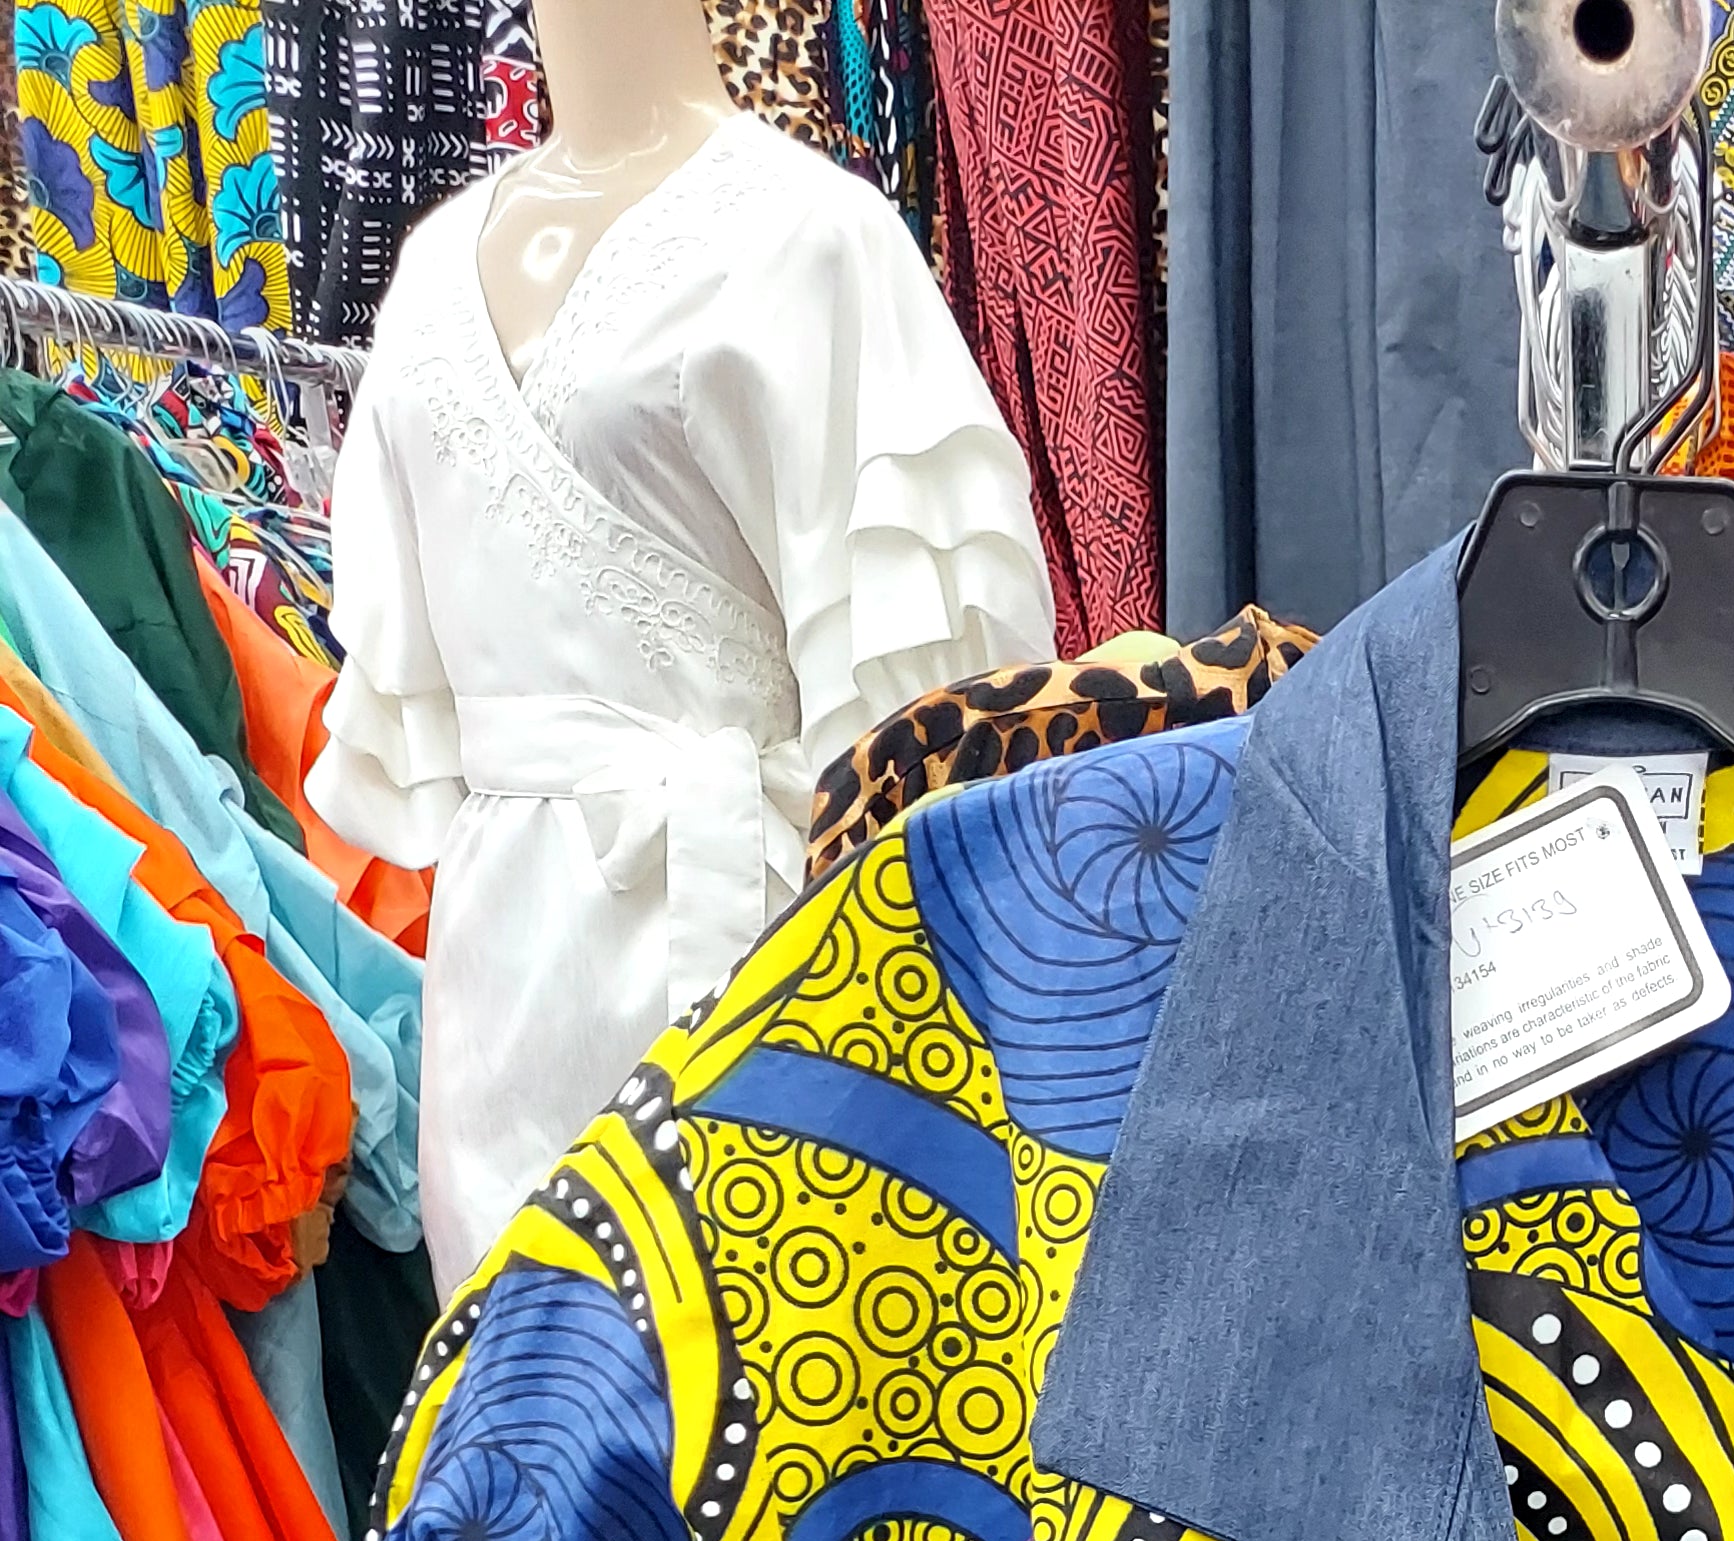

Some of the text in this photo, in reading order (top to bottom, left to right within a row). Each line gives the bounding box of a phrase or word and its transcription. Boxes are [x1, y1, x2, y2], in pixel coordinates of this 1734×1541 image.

[1468, 868, 1505, 894] SIZE
[1505, 851, 1540, 877] FITS
[1541, 827, 1586, 860] MOST
[1452, 961, 1497, 992] 34154
[1463, 937, 1662, 1039] weaving irregularities and shade
[1500, 1028, 1521, 1045] are
[1522, 989, 1600, 1033] characteristic
[1601, 979, 1613, 994] of
[1614, 972, 1635, 988] the
[1636, 954, 1671, 978] fabric
[1476, 1063, 1489, 1076] in
[1492, 1054, 1509, 1069] no
[1512, 1041, 1537, 1059] way
[1540, 1033, 1554, 1046] to
[1556, 1023, 1574, 1038] be
[1612, 997, 1628, 1012] as
